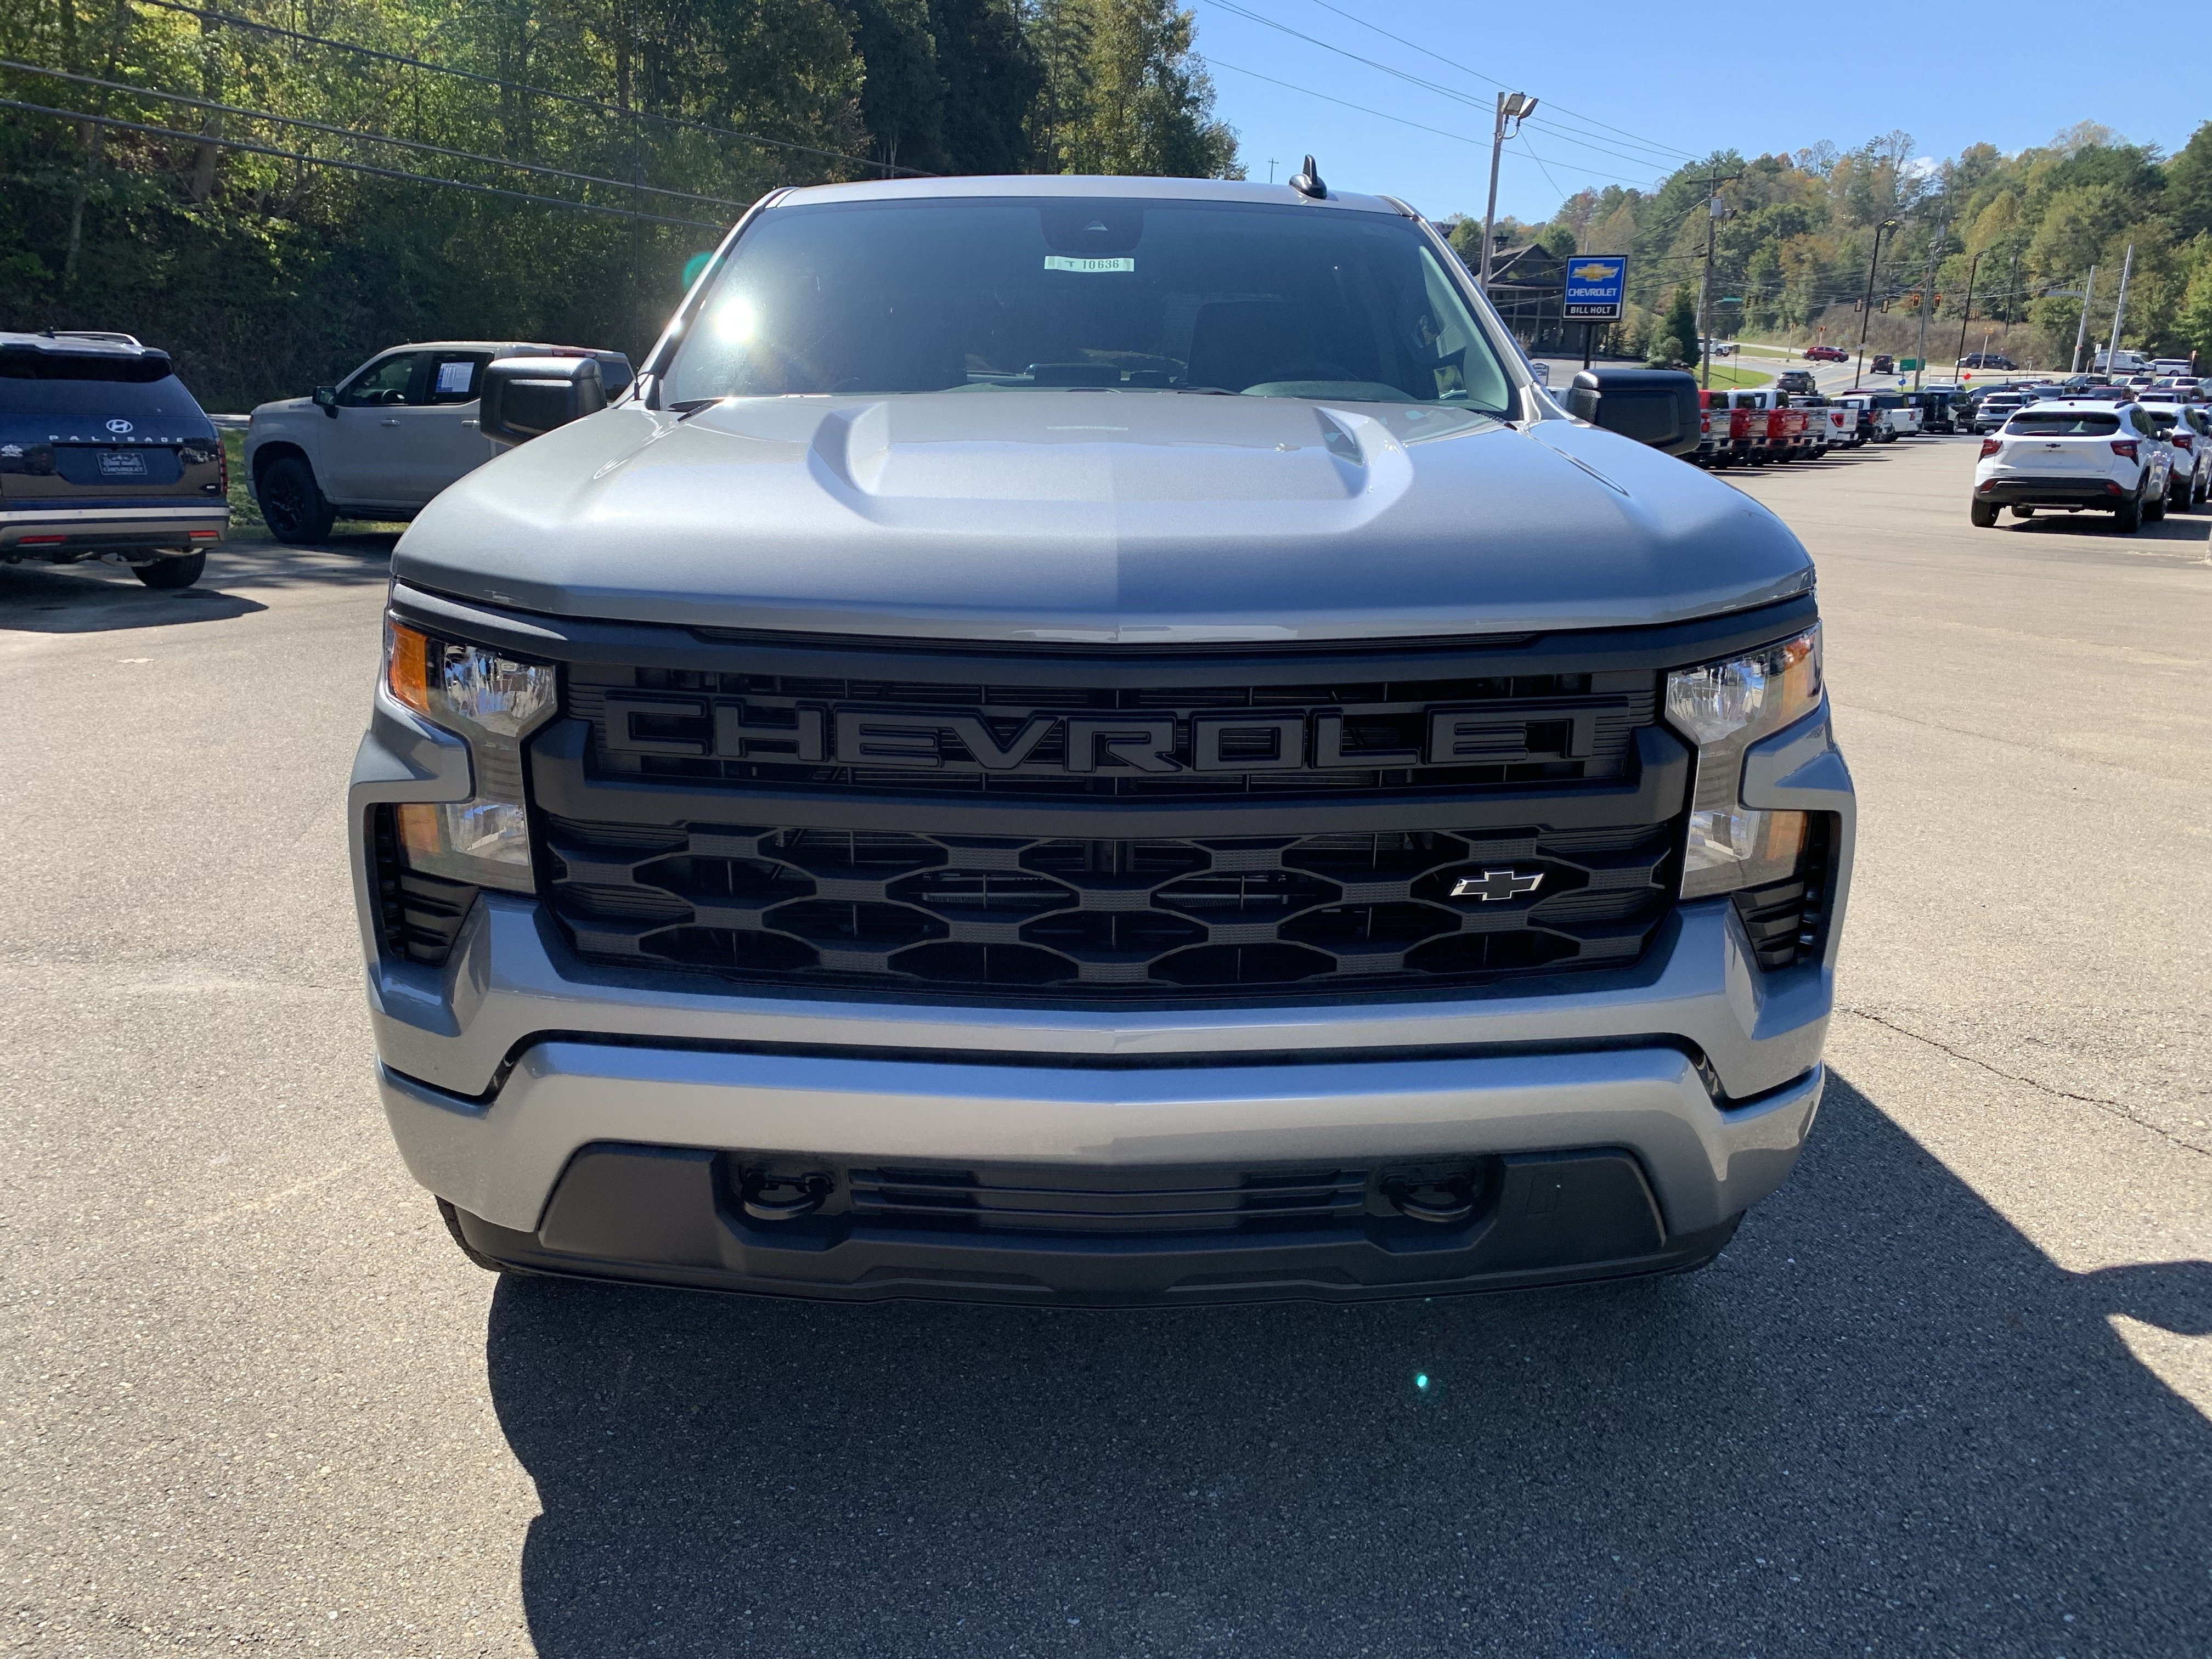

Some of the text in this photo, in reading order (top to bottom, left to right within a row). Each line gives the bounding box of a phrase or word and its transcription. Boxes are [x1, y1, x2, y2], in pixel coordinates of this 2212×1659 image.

[1082, 259, 1119, 269] 10636
[1568, 288, 1618, 297] CHEVROLET
[48, 434, 183, 443] PALISADE
[604, 689, 1630, 774] CHEVROLET
